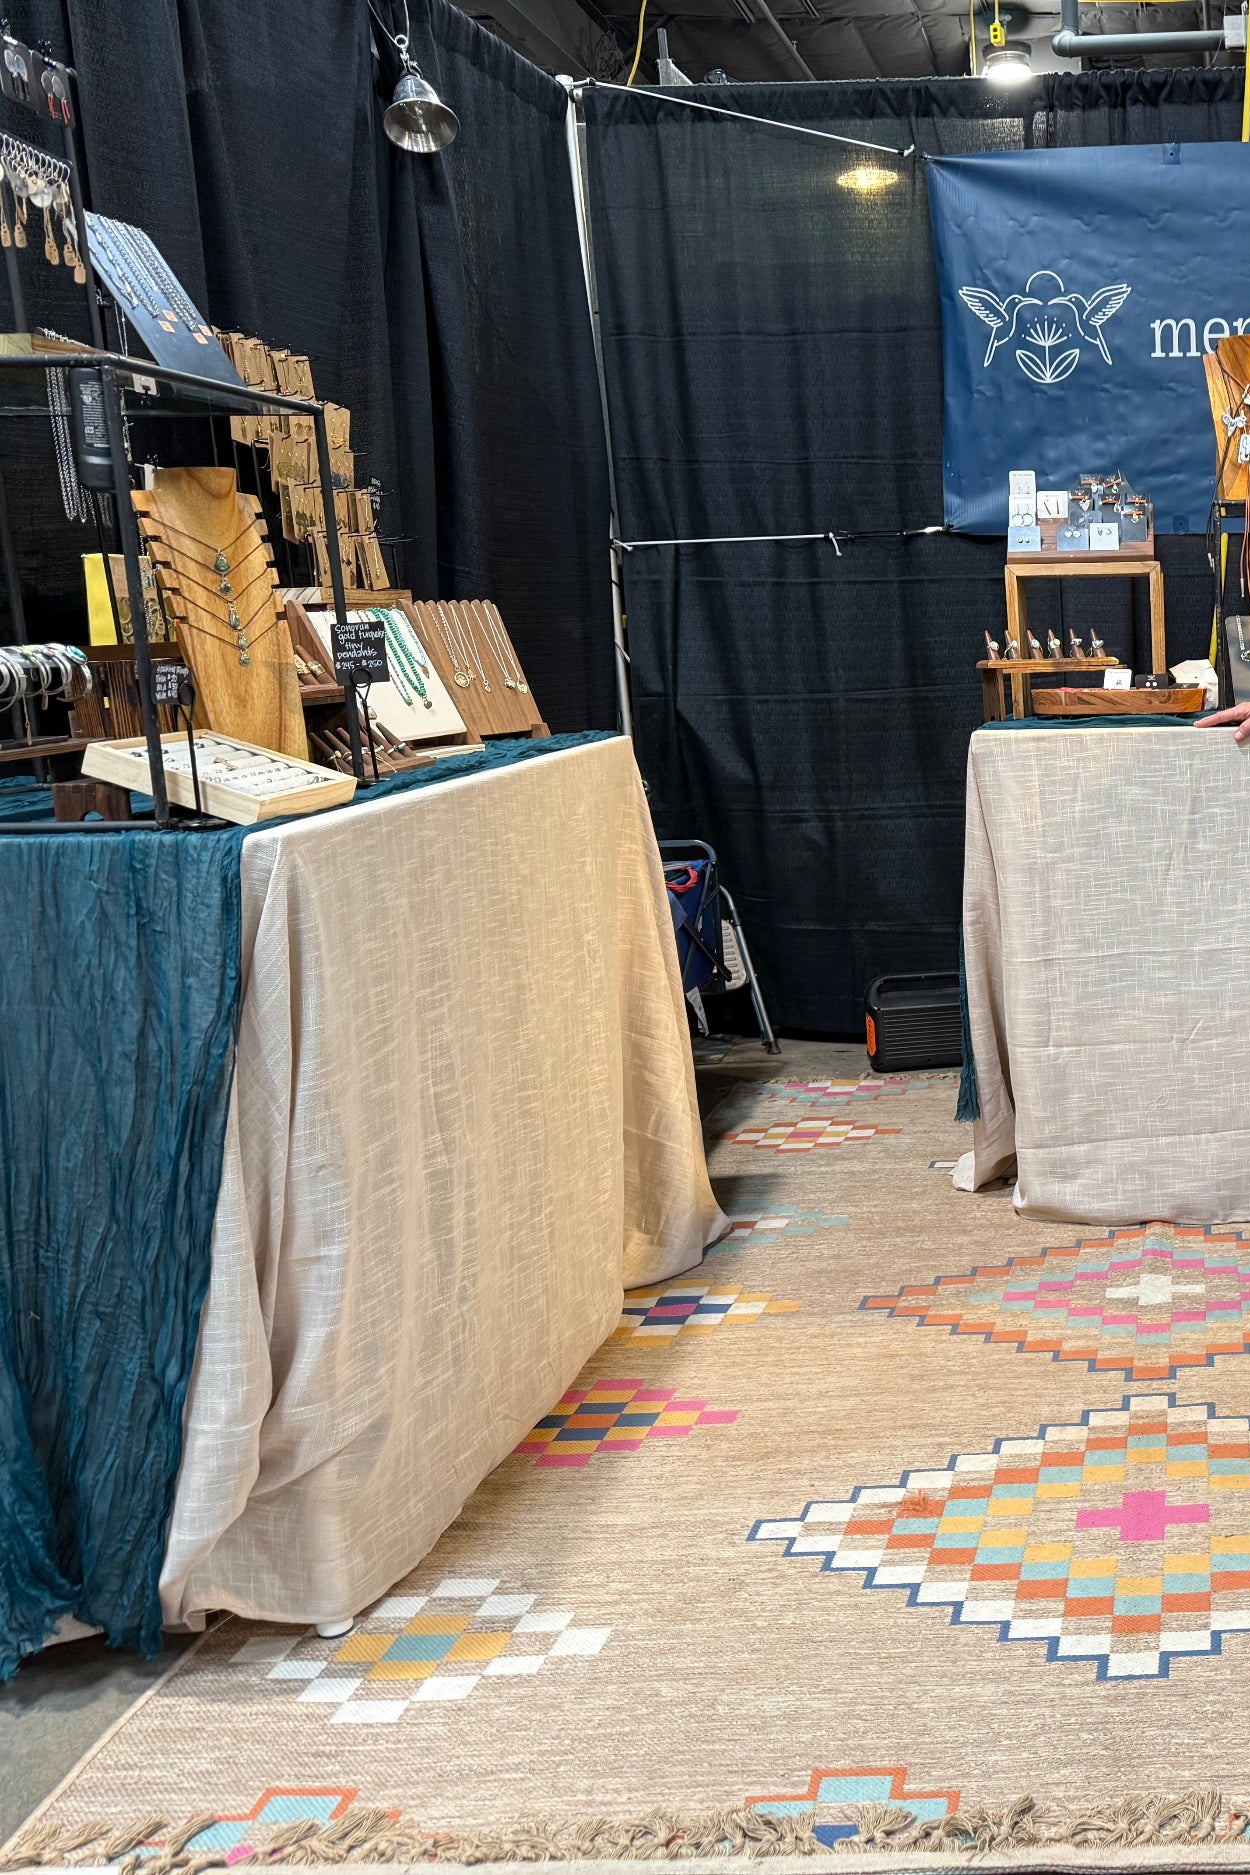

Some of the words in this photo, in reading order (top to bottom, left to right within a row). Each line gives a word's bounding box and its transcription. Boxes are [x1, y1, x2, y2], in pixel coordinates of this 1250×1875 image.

[335, 623, 370, 633] Sonoran
[338, 630, 356, 645] gold
[345, 641, 363, 651] tiny
